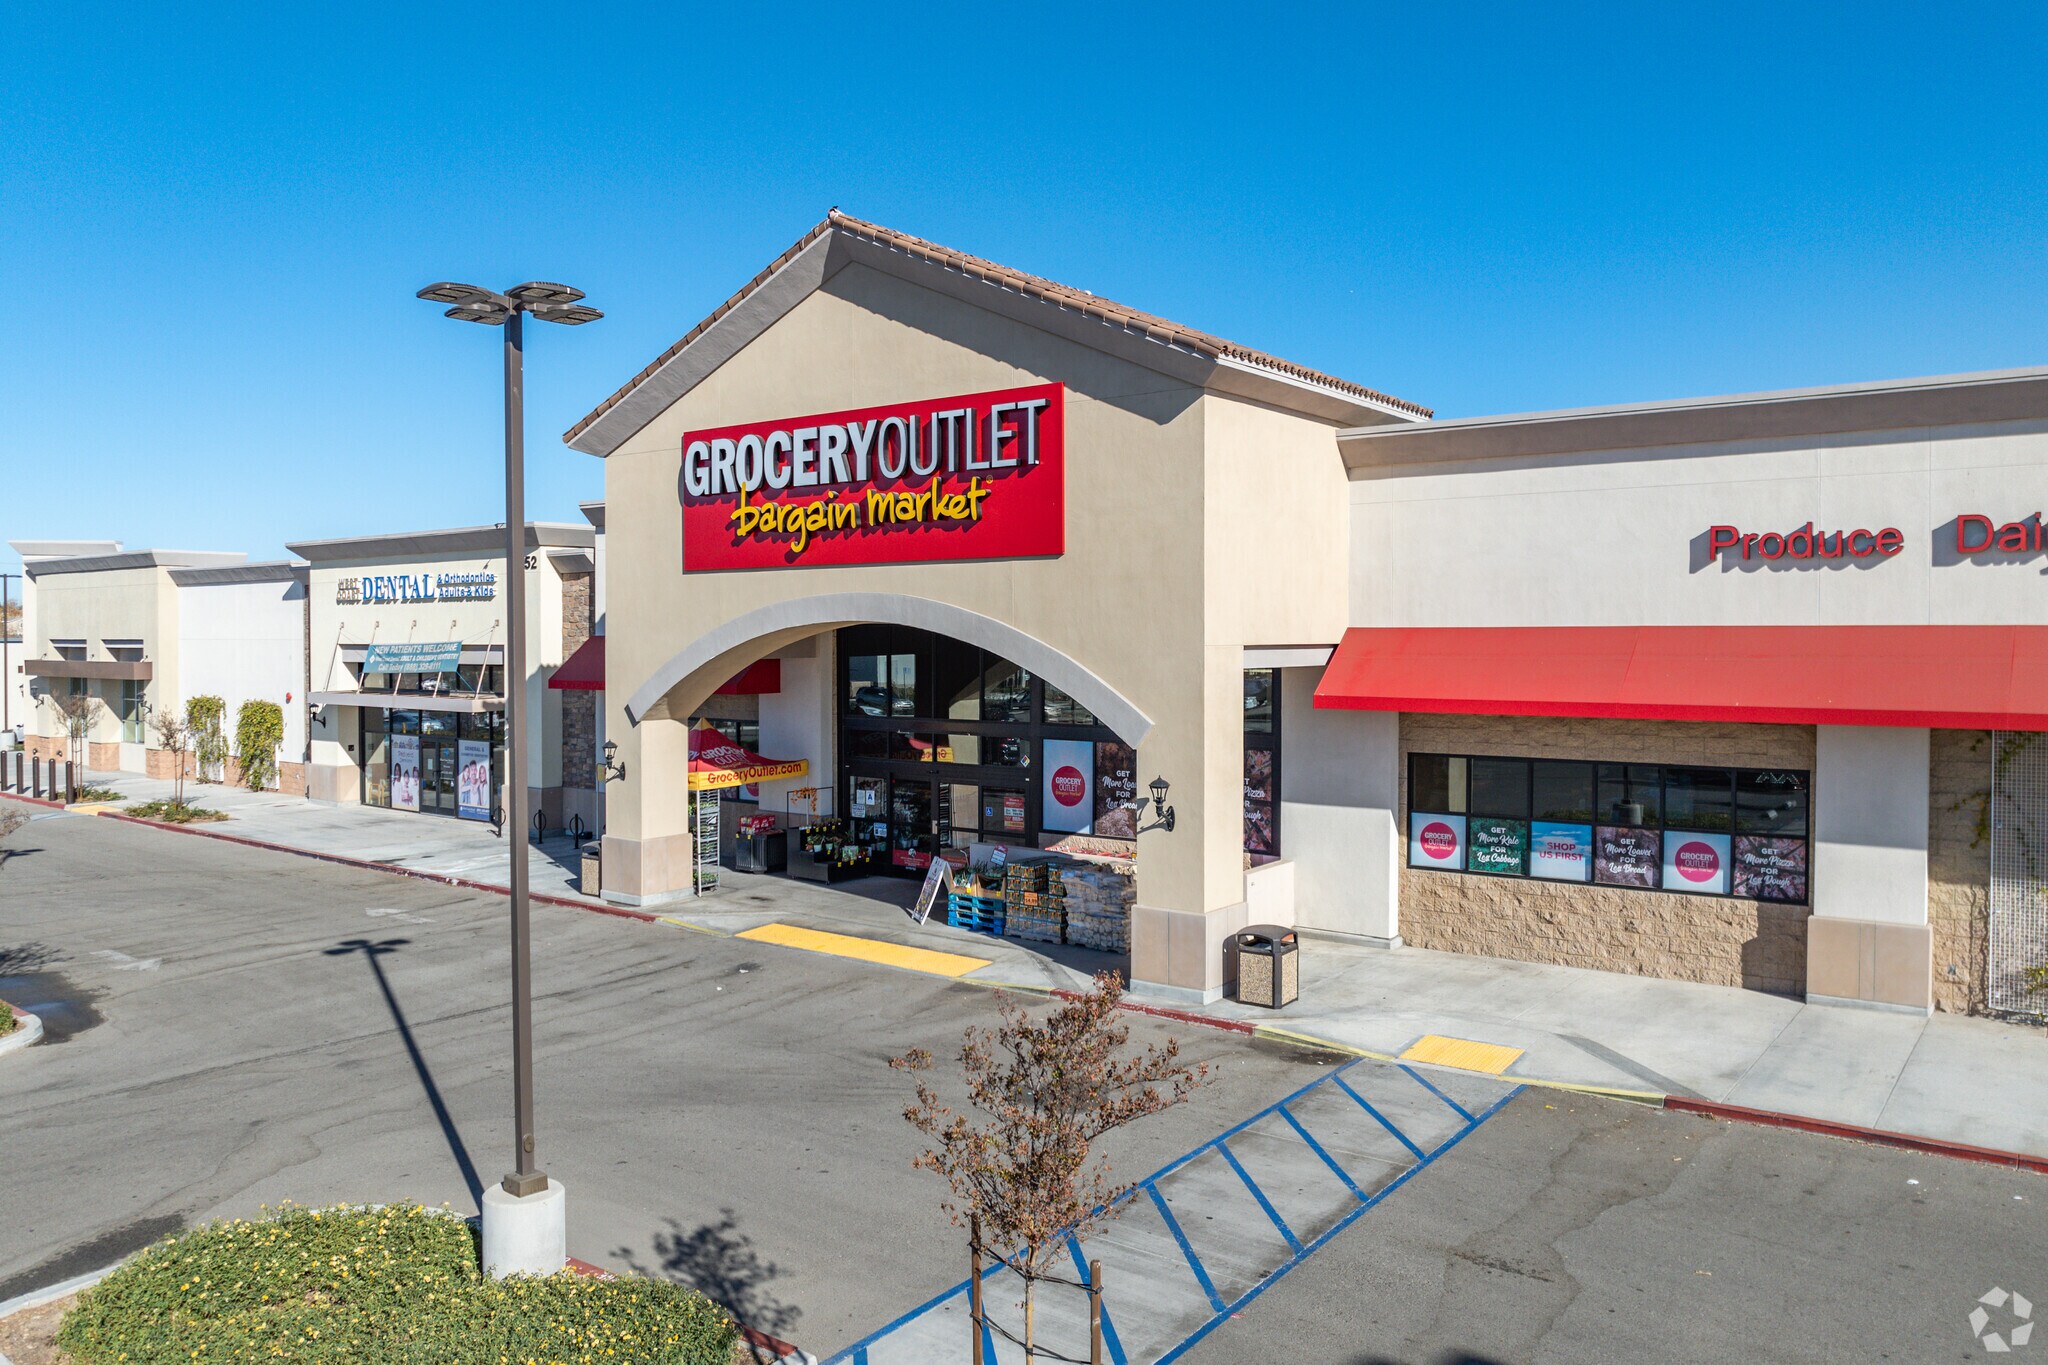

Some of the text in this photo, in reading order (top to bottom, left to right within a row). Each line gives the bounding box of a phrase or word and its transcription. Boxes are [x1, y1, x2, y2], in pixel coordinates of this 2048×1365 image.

[731, 477, 988, 553] bargain market
[1957, 511, 2048, 554] Dai
[1710, 521, 1904, 560] Produce
[338, 577, 358, 589] WEST
[437, 571, 495, 584] & Orthodontics
[362, 574, 435, 601] DENTAL
[439, 585, 494, 598] Adults & Kids
[337, 590, 360, 601] COAST
[375, 642, 459, 654] NEW PATIENTS WELCOME
[707, 764, 803, 784] GroceryOutlet.com
[1055, 776, 1082, 785] GROCERY
[1102, 776, 1122, 788] More
[1058, 784, 1078, 792] OUTLET
[1116, 790, 1131, 798] FOR
[1424, 832, 1453, 840] GROCERY
[1477, 832, 1520, 846] More Kale
[1490, 845, 1506, 853] FOR
[1546, 842, 1576, 851] SHOP
[1604, 843, 1653, 857] More Loaves
[1491, 853, 1520, 867] Cabbage
[1539, 850, 1584, 861] US FIRST
[1680, 852, 1714, 861] GROCERY
[1744, 853, 1796, 867] More Pizza
[1623, 864, 1648, 874] Bread
[1684, 859, 1710, 868] OUTLET
[1760, 867, 1779, 875] FOR
[1763, 875, 1791, 889] Dough
